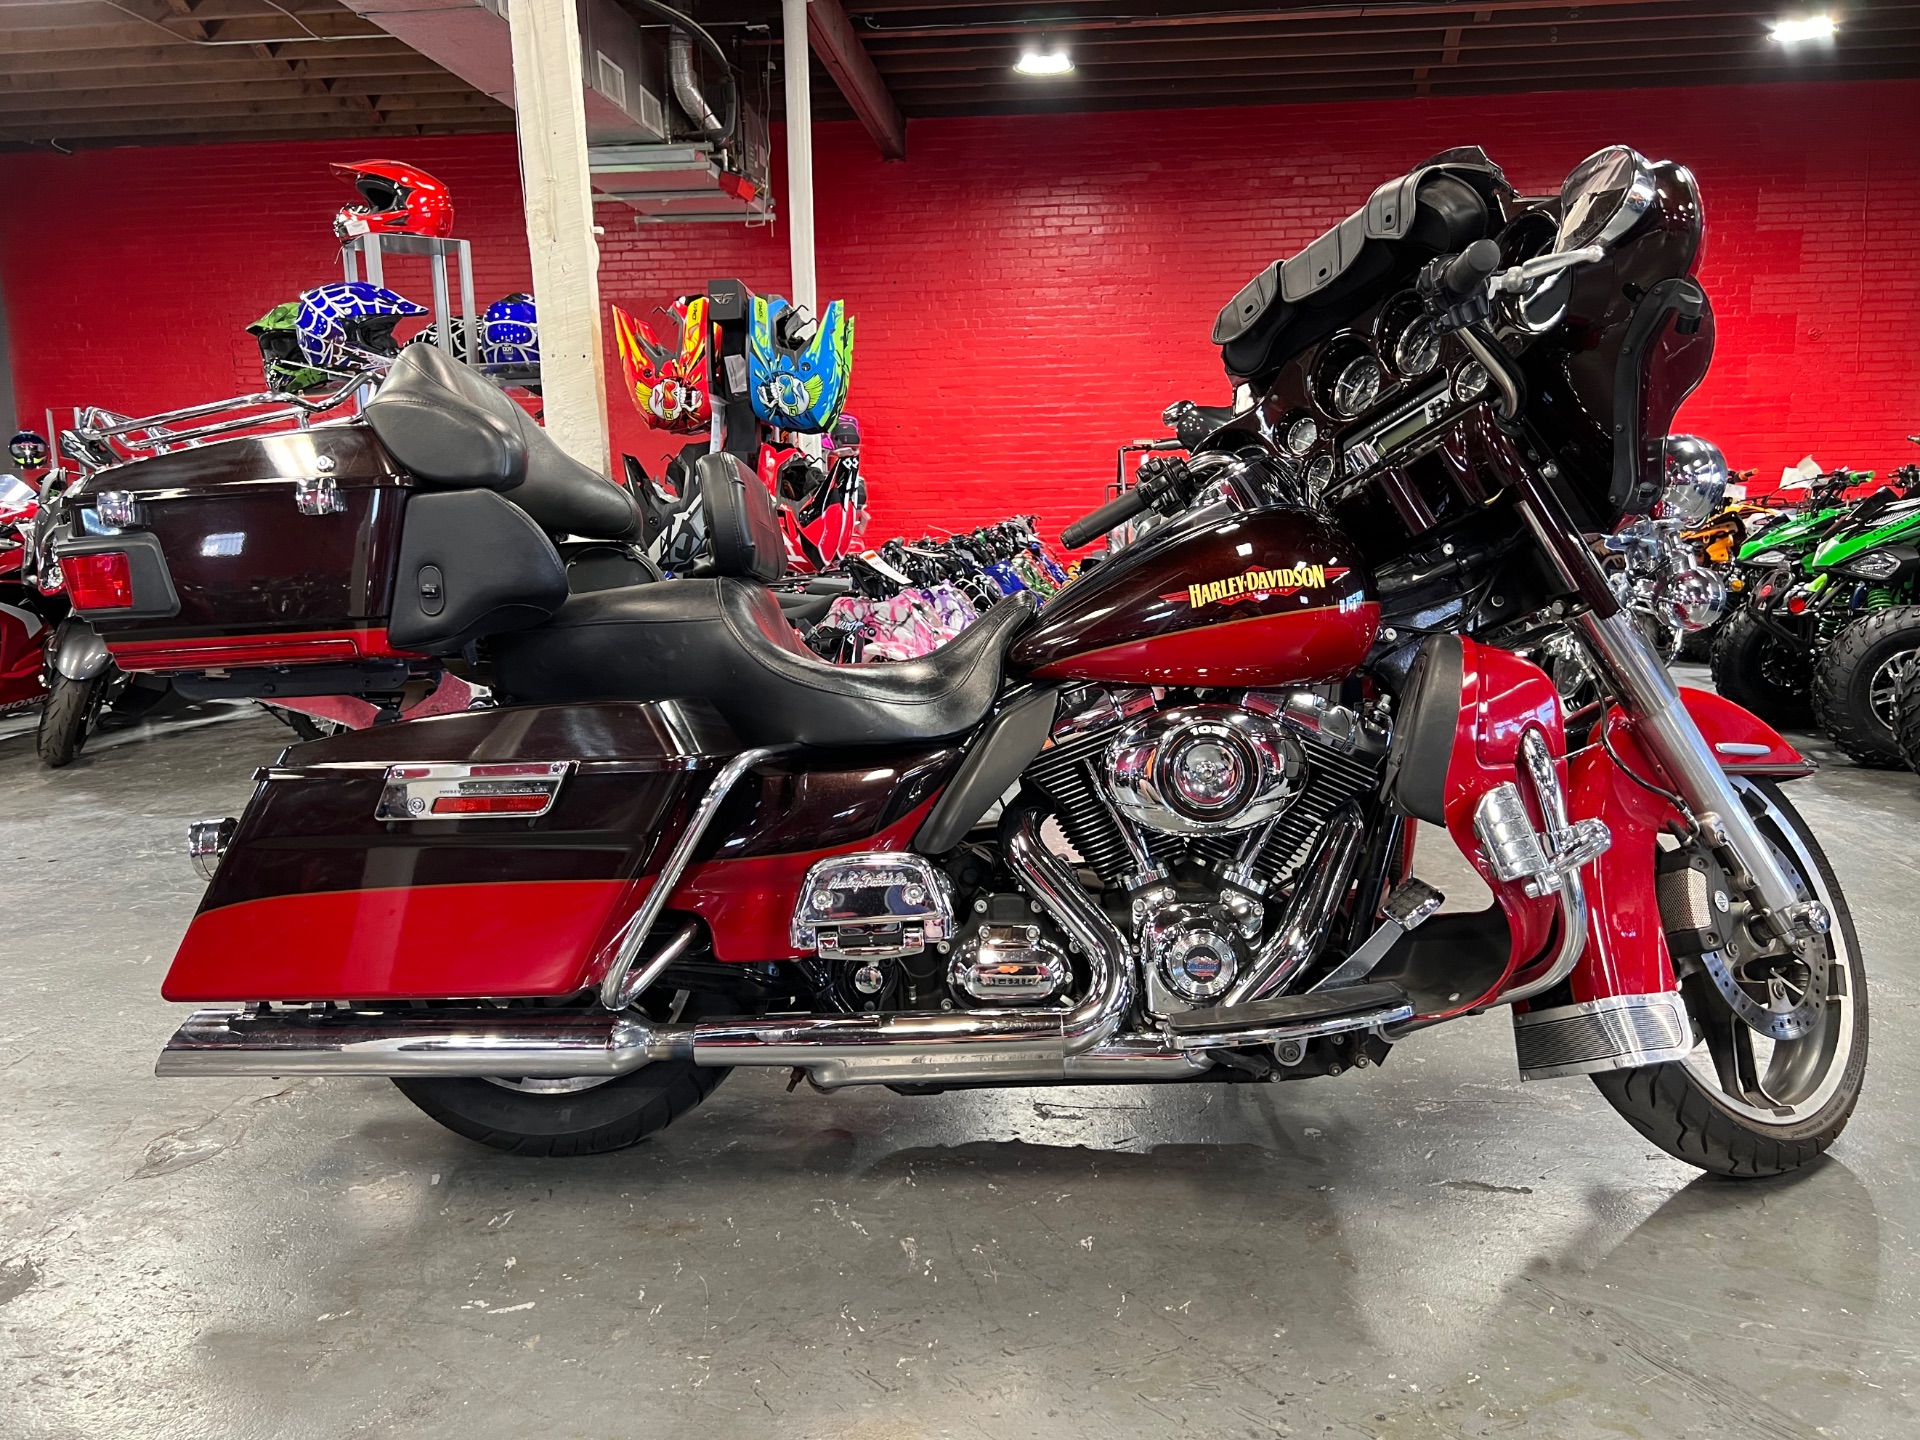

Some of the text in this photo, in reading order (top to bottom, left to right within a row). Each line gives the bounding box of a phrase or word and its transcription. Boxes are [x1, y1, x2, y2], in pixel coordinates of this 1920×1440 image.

[1188, 564, 1326, 609] HARLEY-DAVIDSON
[1228, 588, 1288, 601] MOTORCYCLES
[0, 693, 49, 711] HOND
